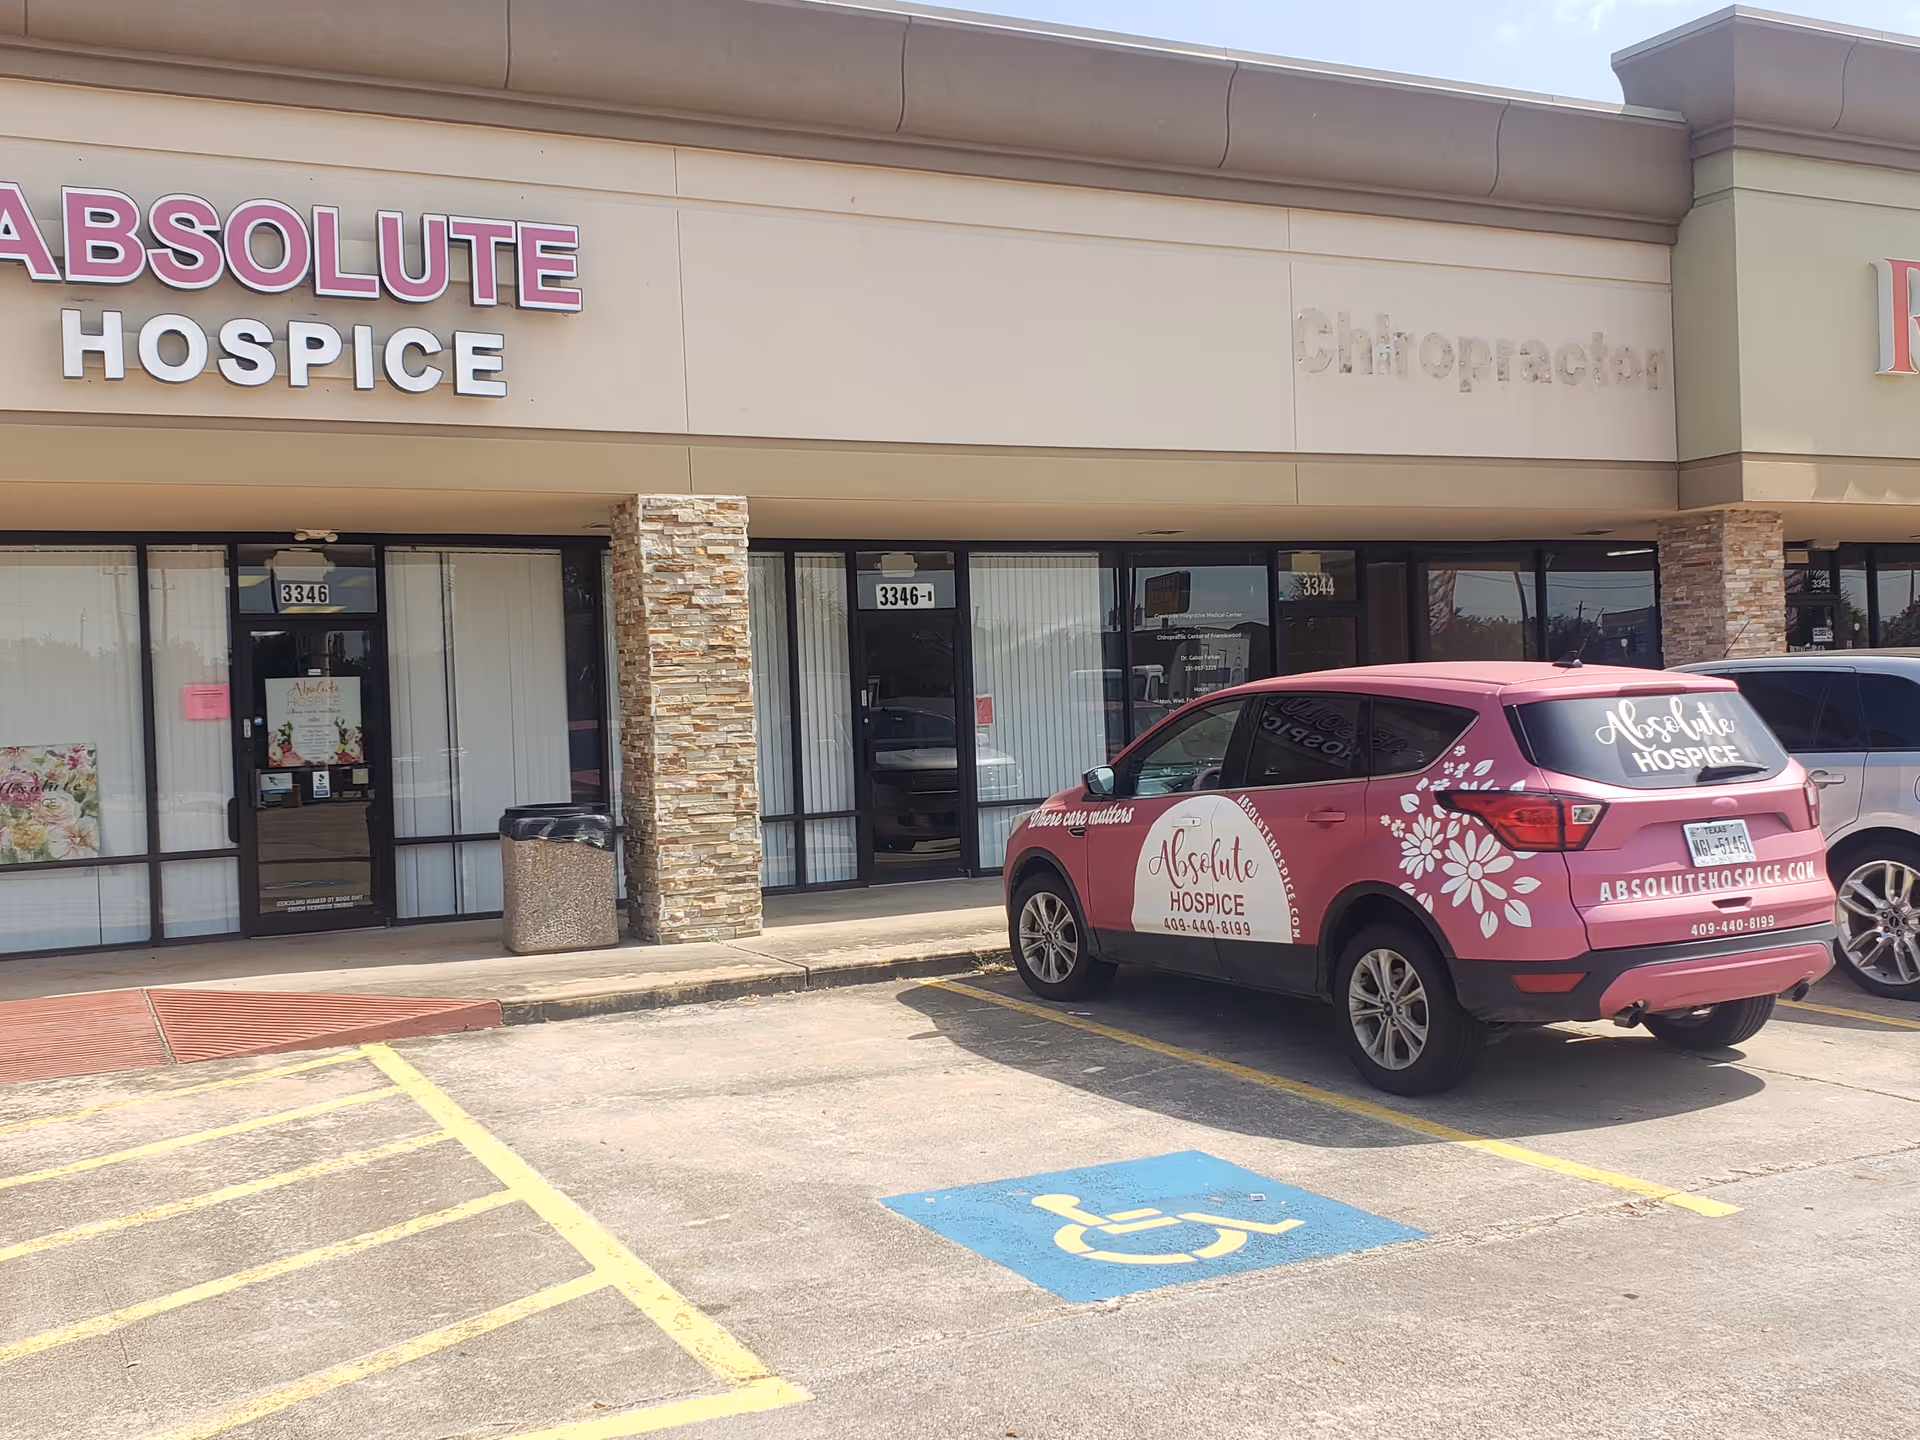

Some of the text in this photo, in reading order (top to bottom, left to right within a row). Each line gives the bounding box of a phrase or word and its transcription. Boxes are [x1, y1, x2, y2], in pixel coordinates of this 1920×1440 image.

[60, 308, 507, 397] HOSPICE
[1295, 306, 1666, 393] Chiropractor
[282, 584, 328, 603] 3346
[1303, 577, 1335, 596] 3344
[1812, 580, 1831, 588] 3342
[1595, 696, 1735, 751] Absolute
[1631, 744, 1745, 773] HOSPICE
[1028, 803, 1135, 829] Where care matters
[1703, 825, 1727, 835] TEXAS
[1148, 828, 1259, 889] Absolute
[1237, 794, 1301, 938] ABSOLUTEHOSPICE.COM
[1600, 860, 1816, 902] ABSOLUTEHOSPICE.COM
[1170, 891, 1245, 917] HOSPICE
[1164, 917, 1251, 937] 409-440-8199
[1691, 914, 1775, 936] 409-440-8199
